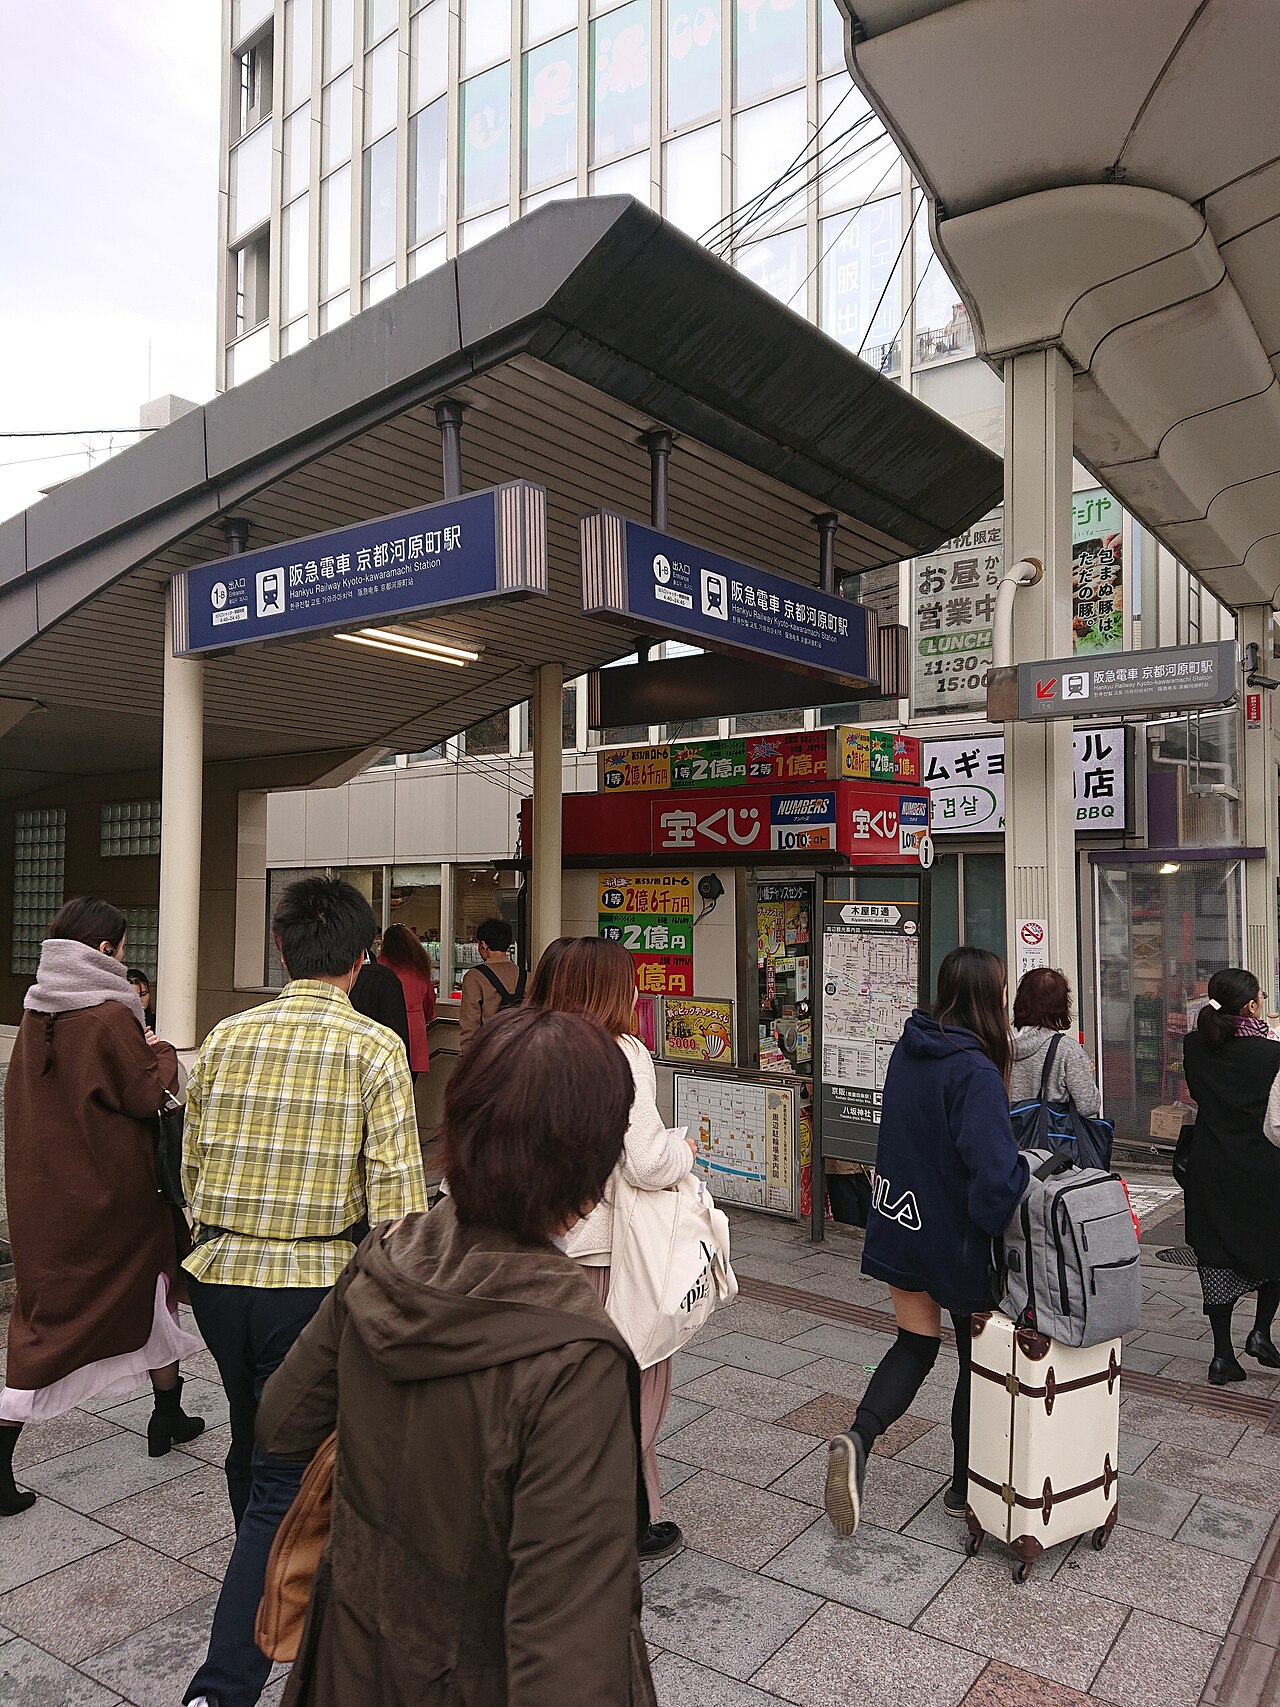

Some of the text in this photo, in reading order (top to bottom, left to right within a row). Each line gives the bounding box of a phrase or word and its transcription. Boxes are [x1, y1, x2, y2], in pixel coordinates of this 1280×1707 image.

[289, 524, 462, 588] 阪急電車 京都河原町駅
[289, 557, 441, 599] Hankyu Railway Kyoto-kawaramachi Station
[672, 560, 691, 575] 出入口
[228, 577, 246, 591] 出入口
[731, 579, 781, 614] 阪急電車
[783, 599, 849, 637] 京都河原町駅
[731, 603, 838, 644] Hankyu Railway Kyoto-kawaramachi Station
[926, 631, 993, 654] LUNCH
[1093, 659, 1213, 684] 阪急電車 京都河原町駅
[1093, 674, 1213, 692] Hankyu Railway Kyoto-kawaramachi Station
[650, 747, 669, 760] ロト6
[1074, 734, 1113, 762] ル
[674, 766, 691, 779] 1等
[691, 757, 747, 780] 2億円
[750, 762, 773, 777] 2等
[776, 754, 827, 777] 1億円
[874, 753, 894, 773] 2億円
[899, 757, 915, 776] 1億円
[606, 772, 622, 785] 1等
[623, 762, 668, 787] 2億6千万円
[1074, 767, 1115, 799] 店
[776, 798, 830, 817] NUMBERS
[1076, 805, 1115, 820] BBQ
[660, 808, 761, 848] 宝くじ
[852, 808, 898, 839] 宝くじ
[777, 829, 811, 851] LOTO
[662, 876, 690, 886] ロト6
[604, 892, 622, 905] 1等
[625, 888, 690, 913] 2億6千万円
[850, 906, 890, 917] 木屋町通
[604, 928, 620, 940] 1等
[623, 925, 686, 950] 2億円
[636, 963, 686, 992] 億円
[842, 1106, 872, 1118] 八坂神社
